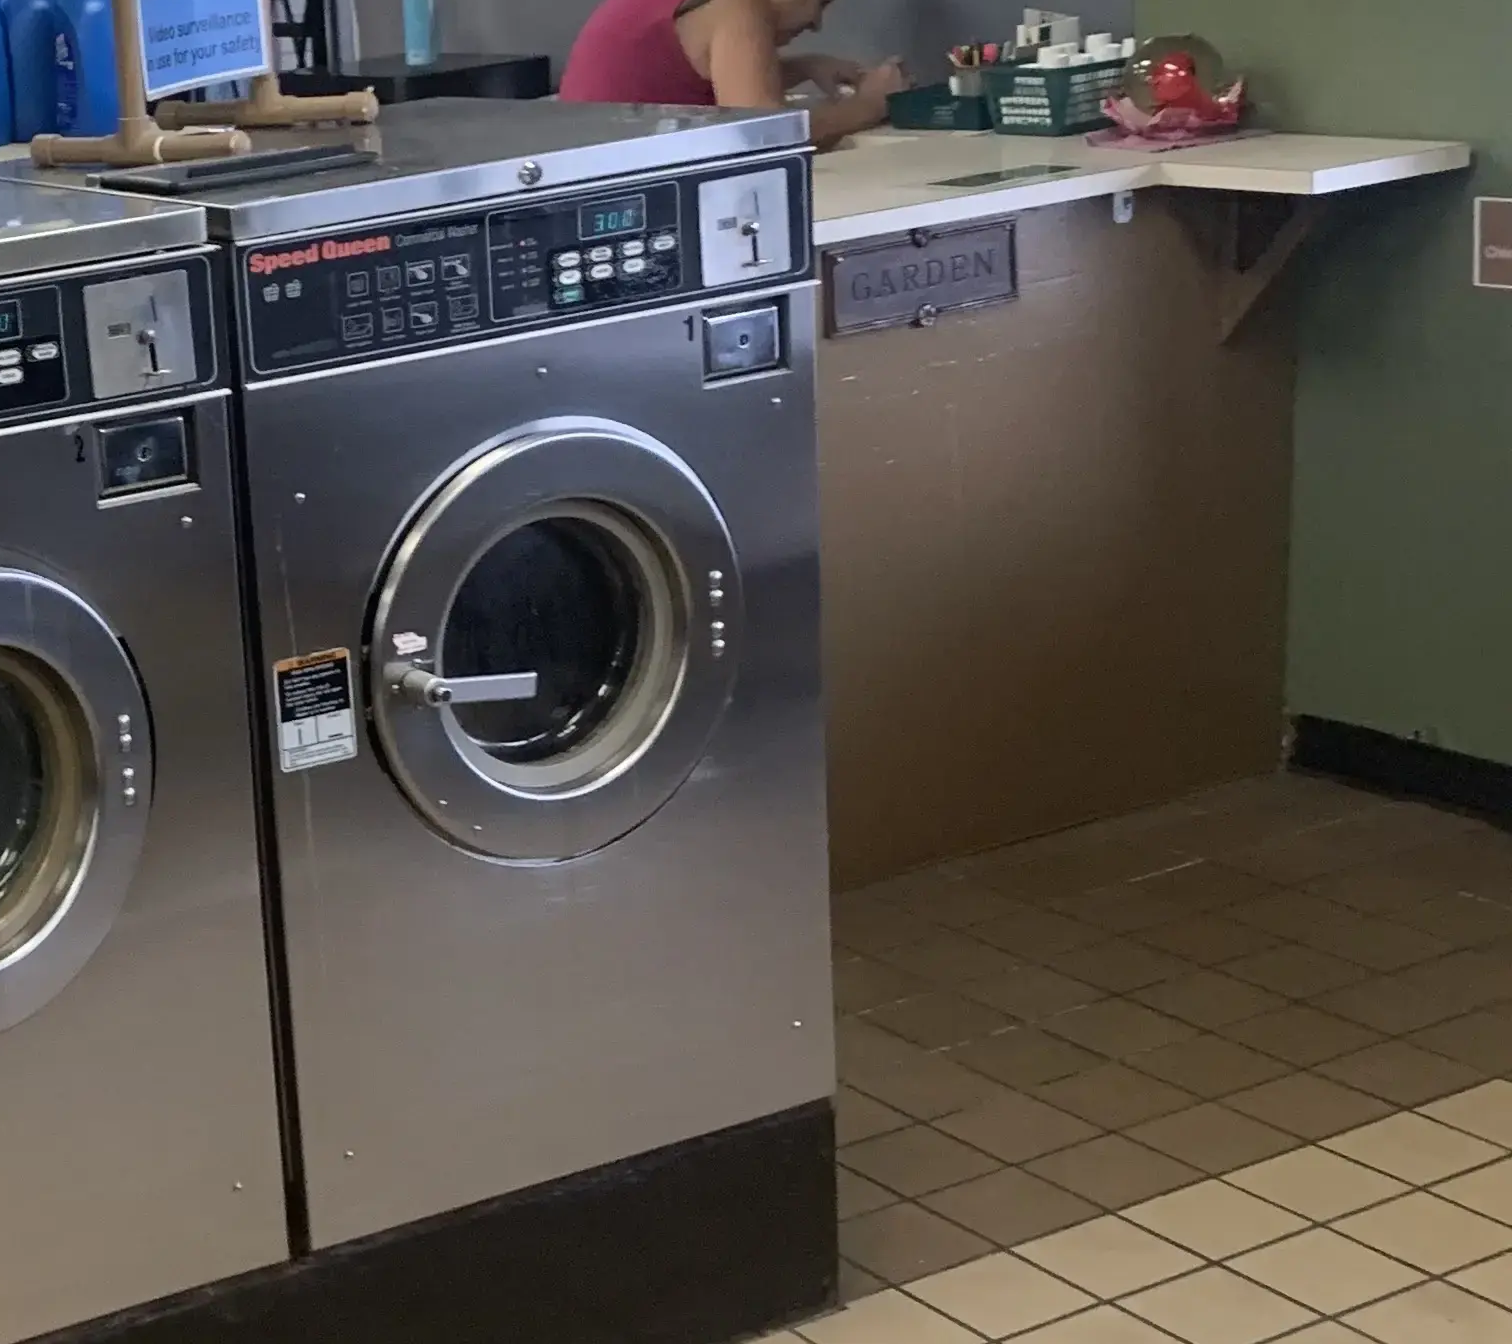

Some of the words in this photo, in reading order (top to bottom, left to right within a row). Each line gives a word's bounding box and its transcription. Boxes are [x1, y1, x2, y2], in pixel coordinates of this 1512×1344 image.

[148, 21, 175, 44] Video
[177, 10, 252, 38] surveillance
[173, 47, 189, 67] for
[190, 43, 218, 67] your
[220, 34, 262, 56] safety
[249, 243, 320, 276] Speed
[321, 234, 391, 259] Queen
[851, 248, 996, 302] GARDEN
[682, 315, 694, 342] 1
[74, 435, 86, 463] 2
